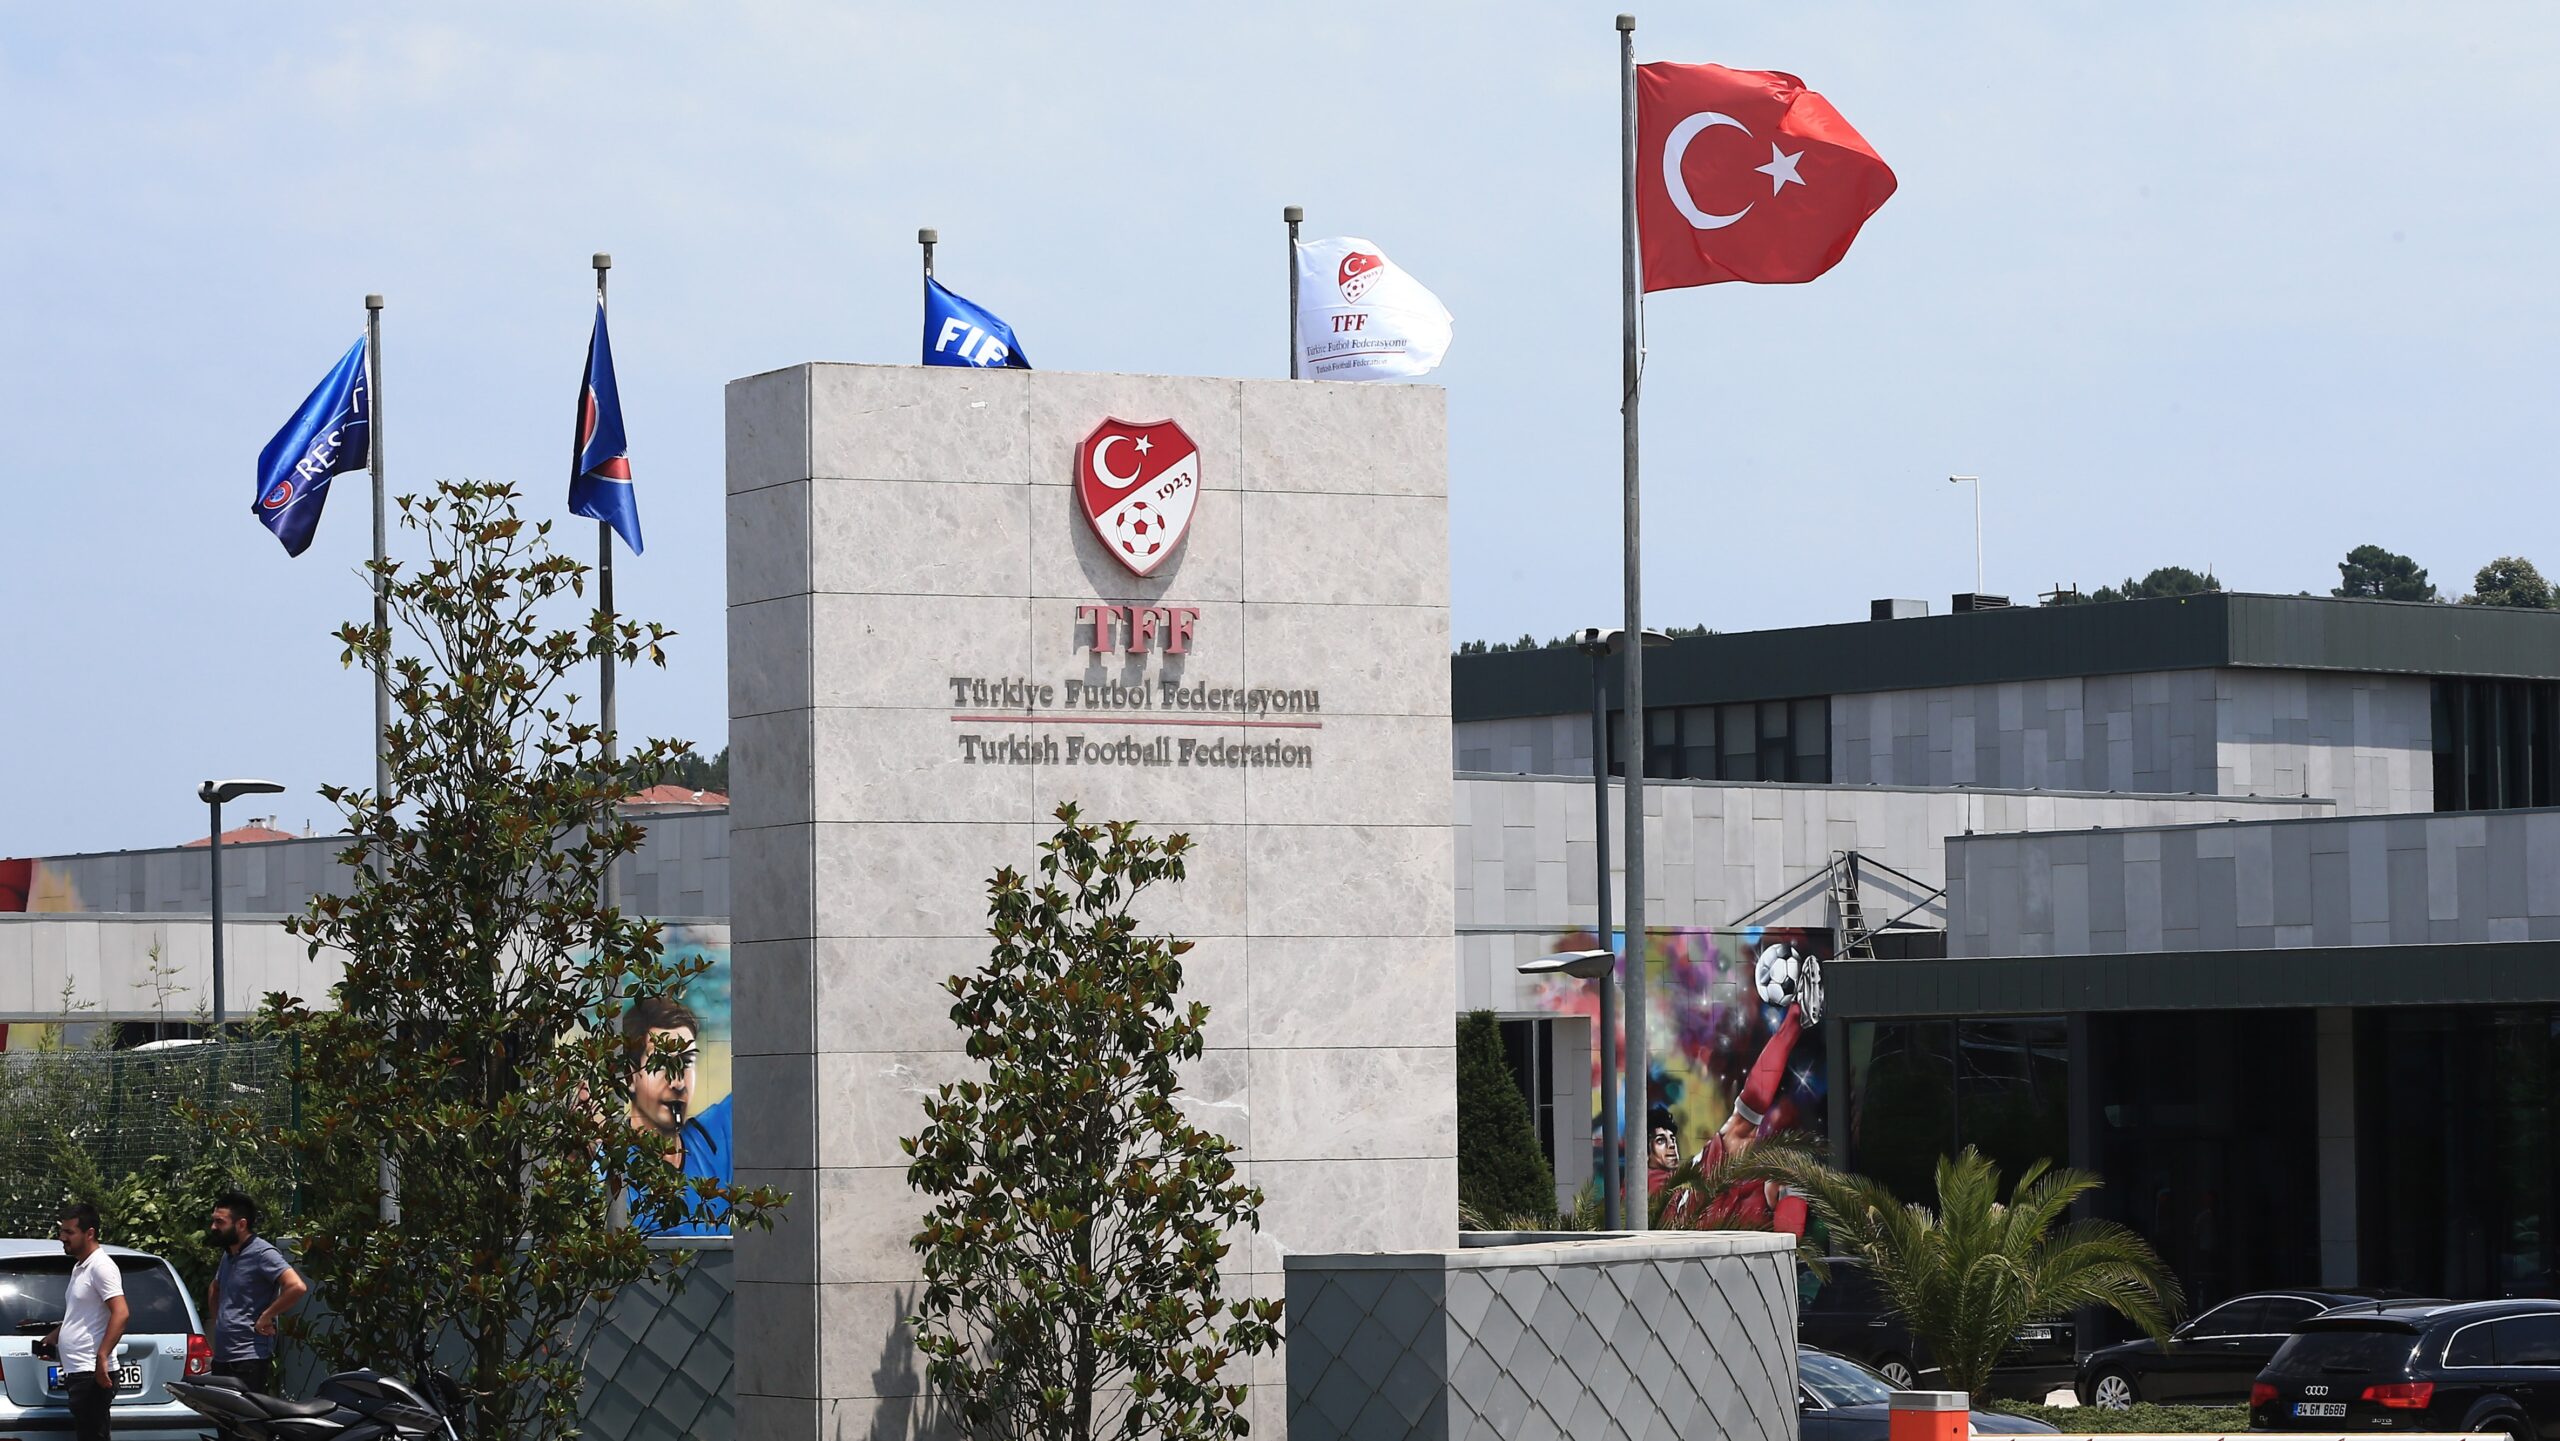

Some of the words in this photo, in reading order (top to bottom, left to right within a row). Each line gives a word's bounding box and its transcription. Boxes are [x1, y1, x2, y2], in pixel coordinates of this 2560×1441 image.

[1331, 313, 1369, 333] TFF
[1328, 339, 1350, 352] Futbol
[1351, 338, 1408, 350] Federasyonu
[1155, 472, 1192, 501] 1923
[1077, 606, 1200, 654] TFF
[950, 676, 1054, 716] Türkiye
[1064, 678, 1152, 710] Futbol
[1160, 680, 1320, 720] Federasyonu
[958, 732, 1060, 766] Turkish
[1065, 735, 1173, 768] Football
[1177, 737, 1313, 769] Federation
[2297, 1403, 2308, 1415] 34
[2310, 1404, 2320, 1415] GM
[2324, 1404, 2345, 1416] 8686
